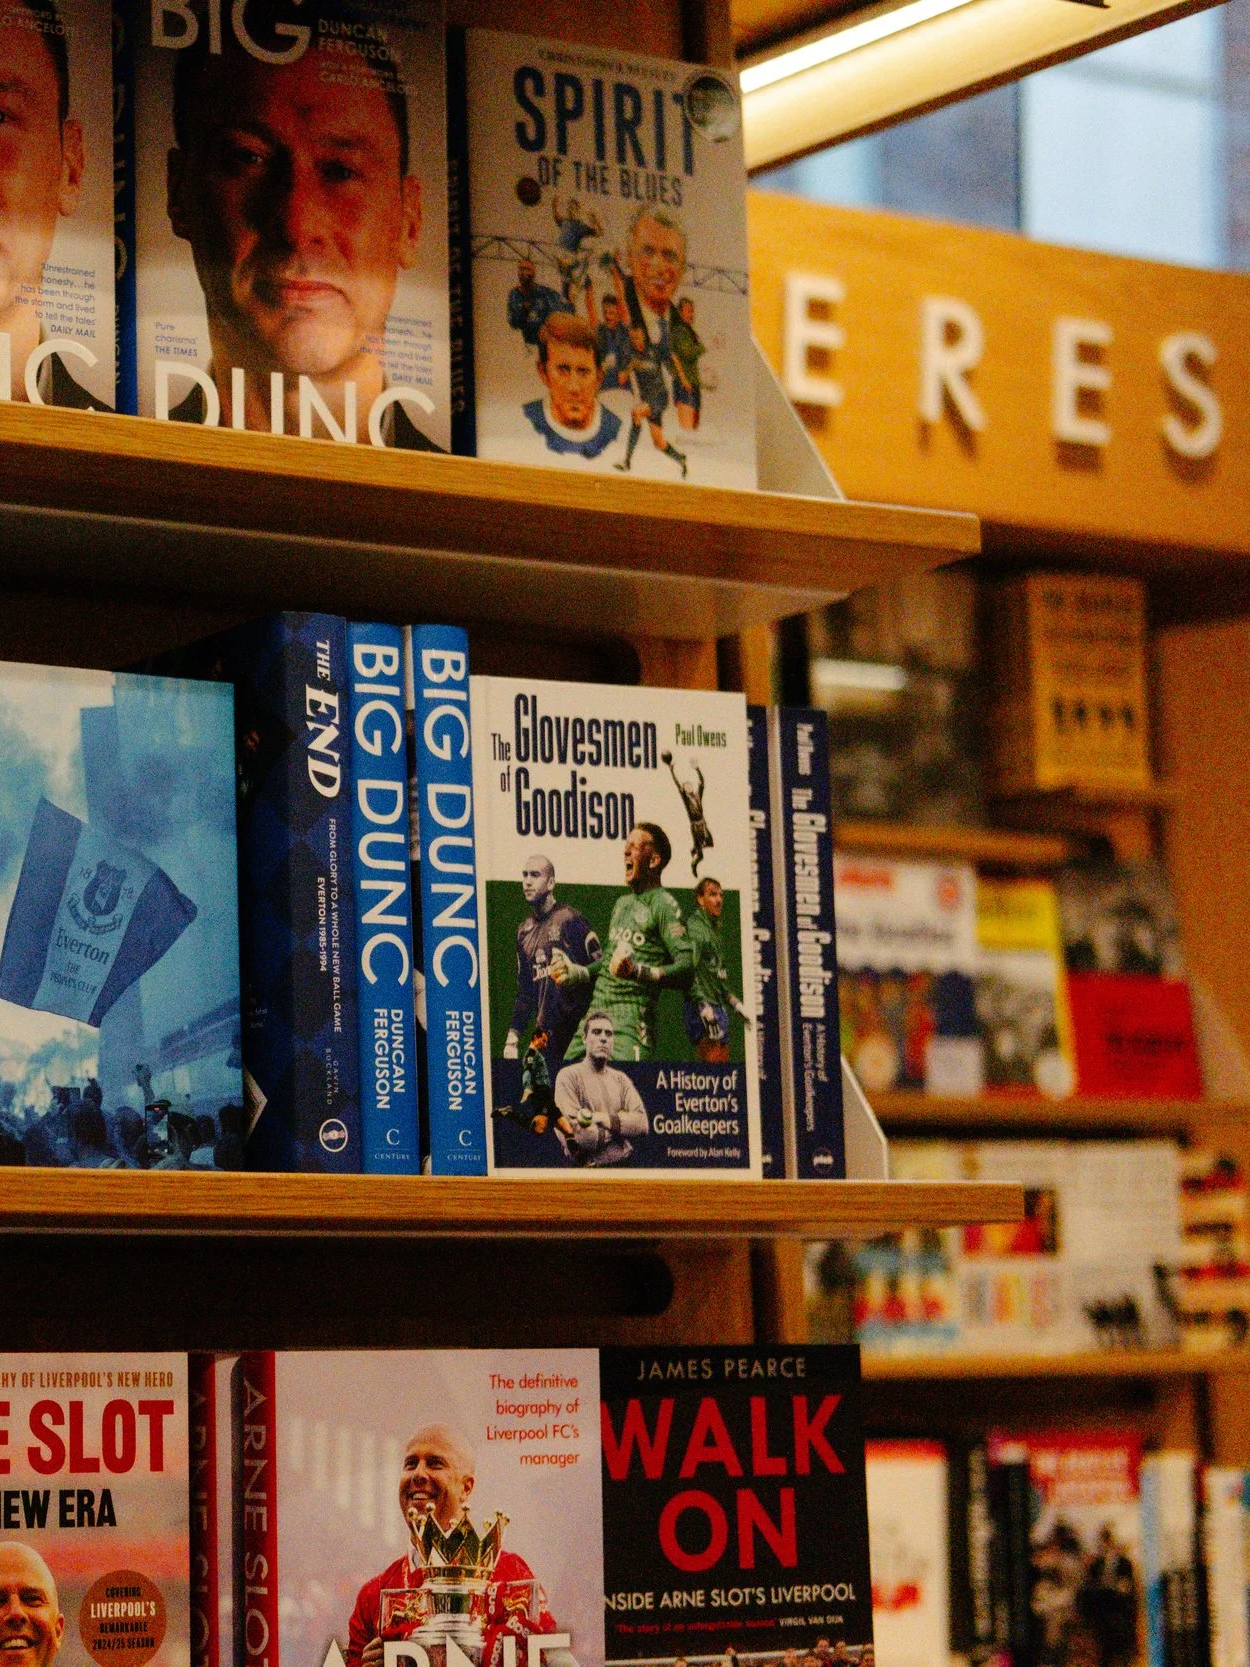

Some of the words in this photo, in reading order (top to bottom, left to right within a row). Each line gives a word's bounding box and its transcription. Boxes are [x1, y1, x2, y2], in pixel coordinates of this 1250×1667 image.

[152, 0, 311, 65] BIG
[318, 19, 388, 41] DUNCAN
[512, 66, 696, 176] SPIRIT
[537, 155, 562, 186] OF
[573, 162, 608, 194] THE
[620, 172, 684, 207] BLUES
[15, 296, 28, 304] the
[31, 298, 54, 308] storm
[57, 301, 73, 310] and
[76, 304, 95, 313] lived
[21, 284, 35, 293] has
[38, 286, 60, 296] been
[63, 290, 95, 302] through
[51, 325, 73, 334] DAILY
[76, 329, 96, 337] MAIL
[316, 640, 330, 681] THE
[354, 644, 402, 756] BIG
[422, 649, 469, 761] BIG
[305, 684, 341, 798] END
[491, 733, 511, 762] The
[514, 693, 657, 769] Glovesmen
[675, 723, 695, 747] Paul
[697, 725, 727, 748] Owens
[500, 764, 511, 793] of
[515, 766, 636, 840] Goodison
[330, 851, 338, 881] GLORY
[357, 779, 410, 986] DUNC
[427, 783, 478, 988] DUNC
[318, 877, 326, 924] EVERTON
[331, 881, 338, 900] TO
[56, 927, 110, 965] Everton
[331, 909, 339, 948] WHOLE
[332, 951, 340, 975] NEW
[797, 931, 832, 1018] Goodison
[333, 977, 341, 1000] BALL
[374, 1008, 390, 1109] FERGUSON
[390, 1009, 405, 1093] DUNCAN
[445, 1011, 462, 1111] FERGUSON
[462, 1011, 477, 1095] DUNCAN
[656, 1074, 669, 1090] A
[670, 1070, 720, 1096] History
[722, 1070, 738, 1090] of
[675, 1092, 738, 1113] Everton's
[653, 1113, 739, 1140] Goalkeepers
[667, 1147, 698, 1158] Foreword
[699, 1148, 707, 1159] by
[708, 1148, 723, 1158] Alan
[724, 1148, 741, 1159] Kelly
[22, 1372, 35, 1388] OF
[40, 1371, 113, 1388] LIVERPOOL'S
[117, 1371, 141, 1388] NEW
[144, 1371, 174, 1388] HERO
[489, 1374, 514, 1389] The
[518, 1374, 578, 1389] definitive
[637, 1358, 712, 1381] JAMES
[724, 1356, 806, 1378] PEARCE
[496, 1398, 562, 1417] biography
[565, 1398, 579, 1414] of
[28, 1399, 174, 1475] SLOT
[486, 1425, 548, 1443] Liverpool
[552, 1424, 580, 1440] FC's
[600, 1393, 847, 1481] WALK
[244, 1377, 268, 1532] ARNE
[520, 1452, 580, 1468] manager
[59, 1489, 117, 1528] ERA
[658, 1486, 798, 1572] ON
[91, 1601, 156, 1619] LIVERPOOL'S
[605, 1591, 654, 1611] NSIDE
[660, 1589, 705, 1608] ARNE
[710, 1586, 766, 1606] SLOT'S
[771, 1583, 856, 1604] LIVERPOOL
